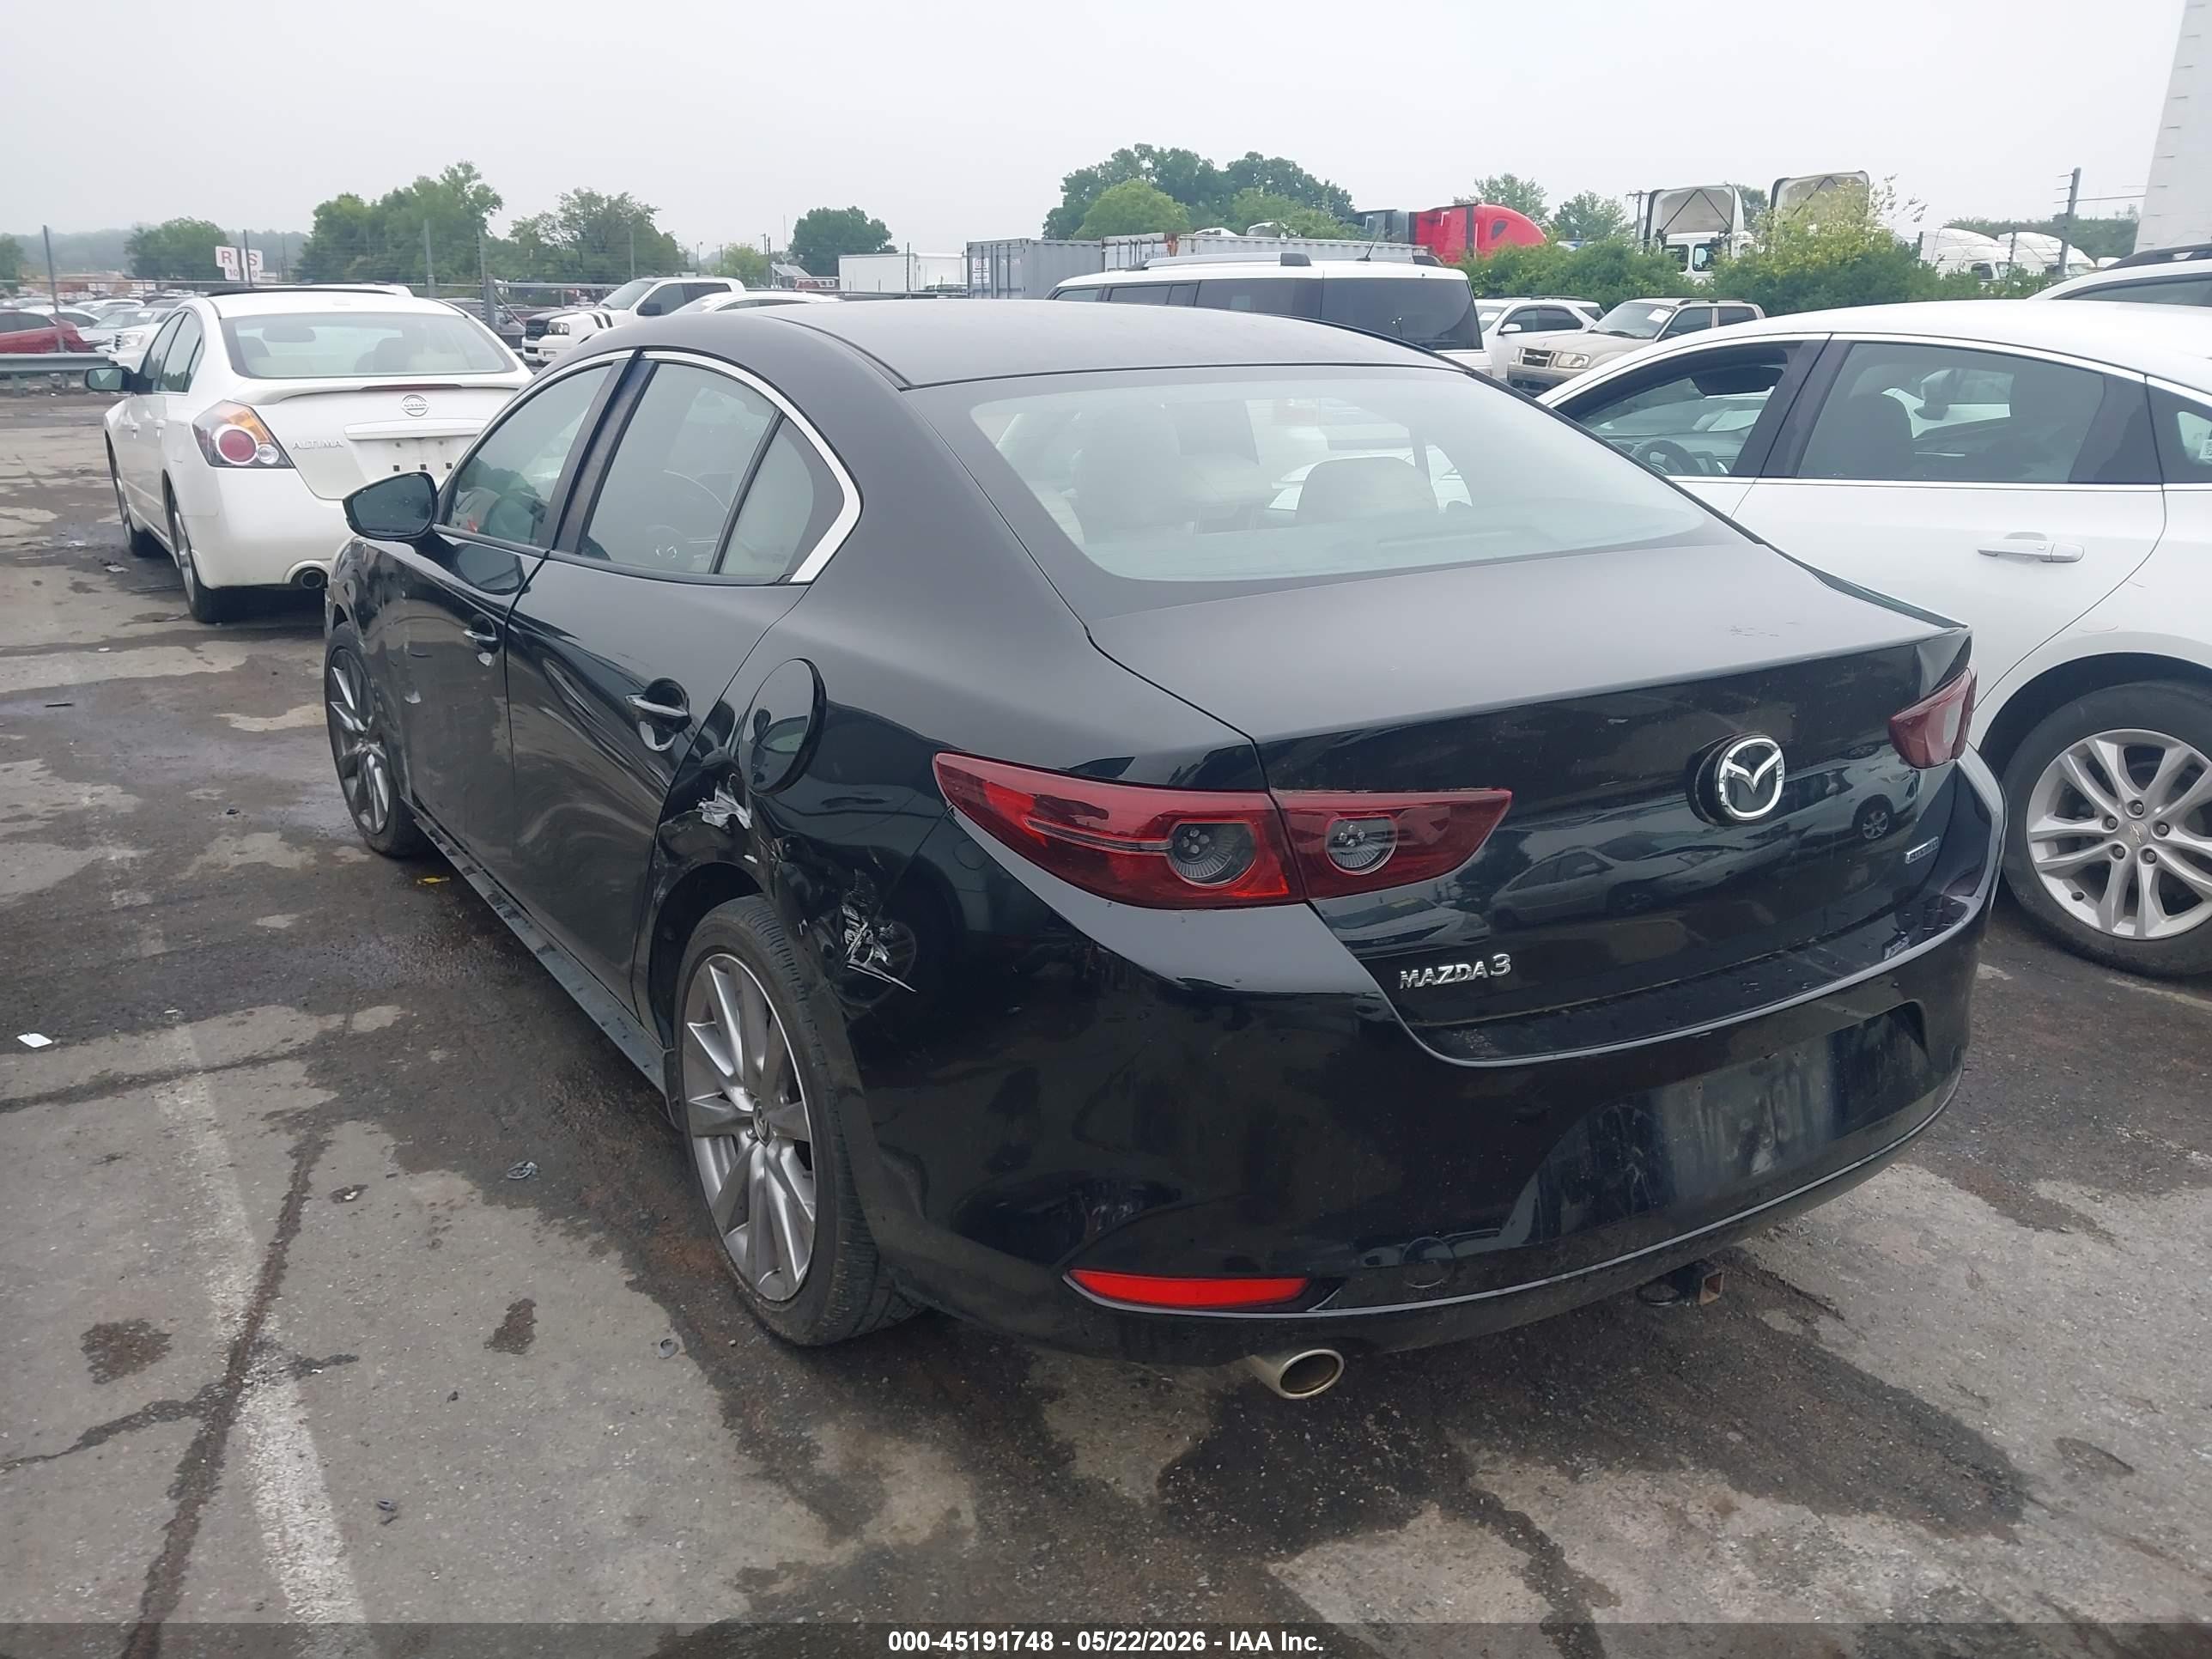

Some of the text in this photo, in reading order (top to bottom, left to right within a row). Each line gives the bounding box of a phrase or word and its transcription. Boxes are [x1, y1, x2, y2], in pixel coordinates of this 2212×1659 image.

[221, 250, 233, 264] R
[248, 252, 258, 266] S
[292, 439, 343, 450] ALTIMA
